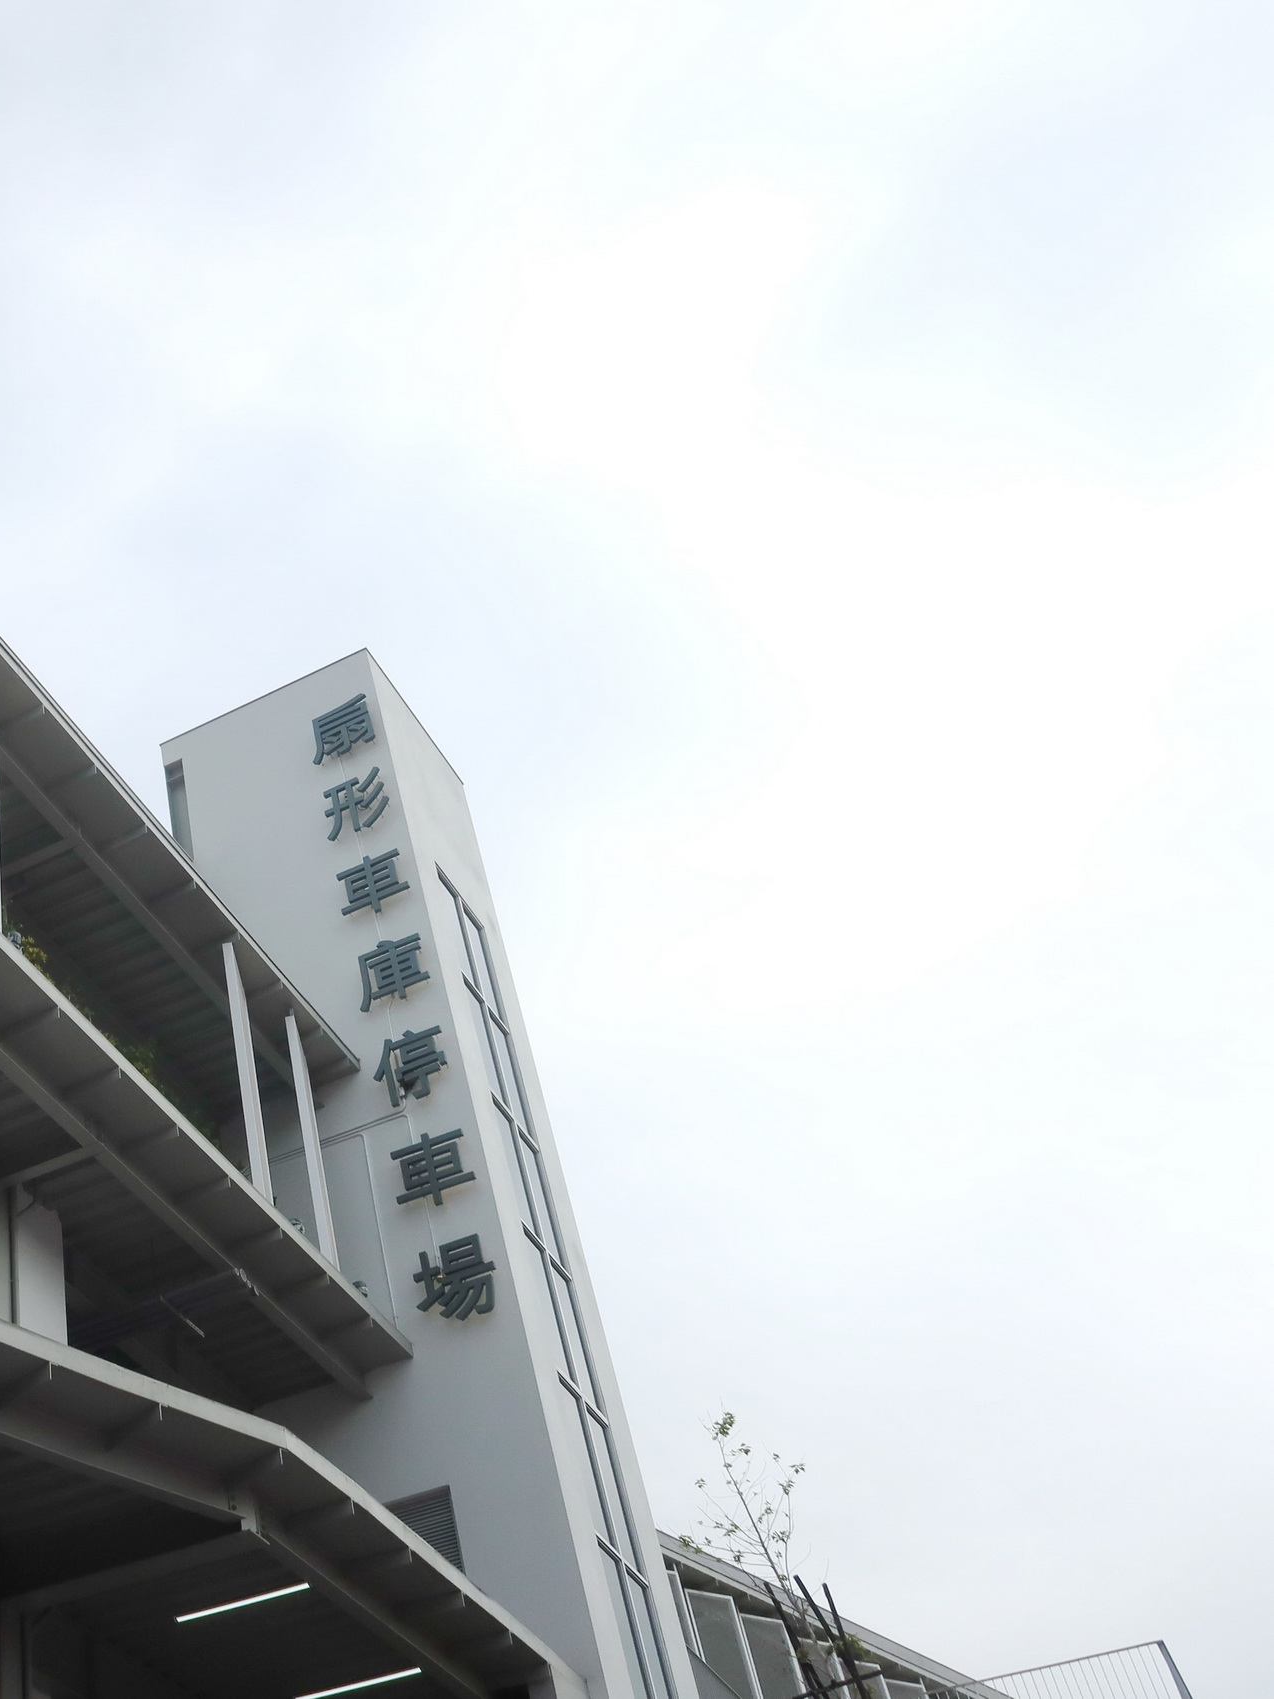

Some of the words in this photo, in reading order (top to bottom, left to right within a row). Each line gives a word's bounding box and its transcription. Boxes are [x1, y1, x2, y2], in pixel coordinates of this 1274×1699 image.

[312, 693, 496, 1321] 扇形車庫停車場
